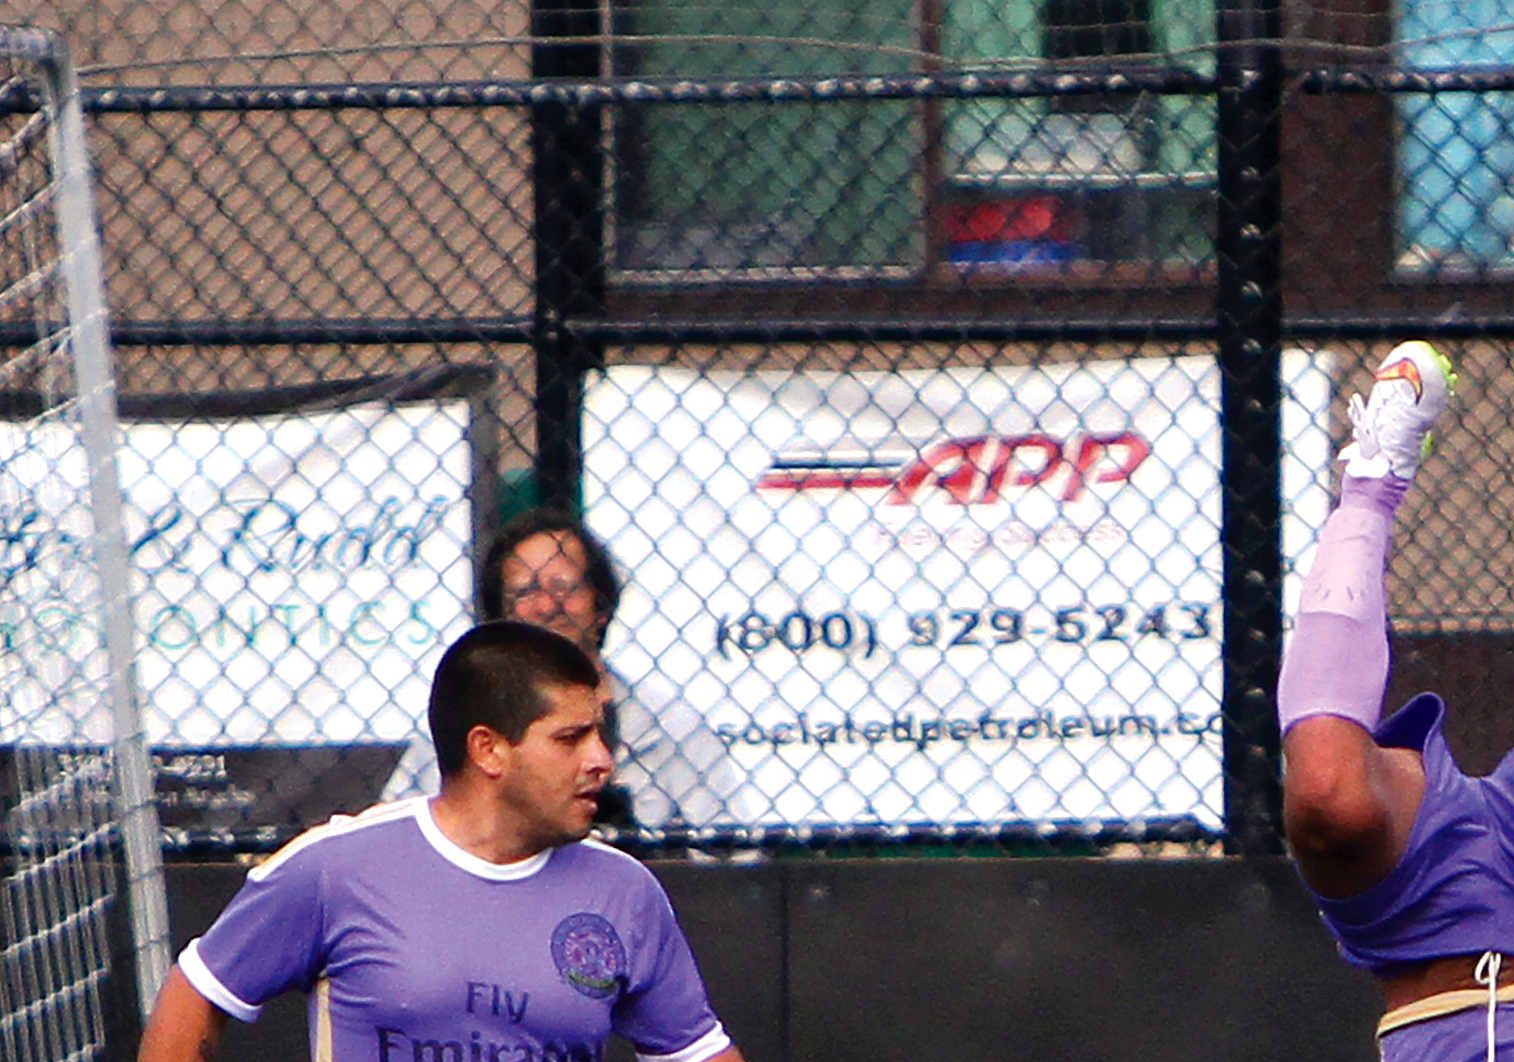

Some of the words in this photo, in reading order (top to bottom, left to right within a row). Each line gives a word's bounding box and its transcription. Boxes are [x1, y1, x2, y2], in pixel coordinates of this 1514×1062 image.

[885, 430, 1152, 506] APP
[715, 610, 879, 660] (800)
[905, 604, 1215, 648] 929-5243
[465, 981, 529, 1025] Fly
